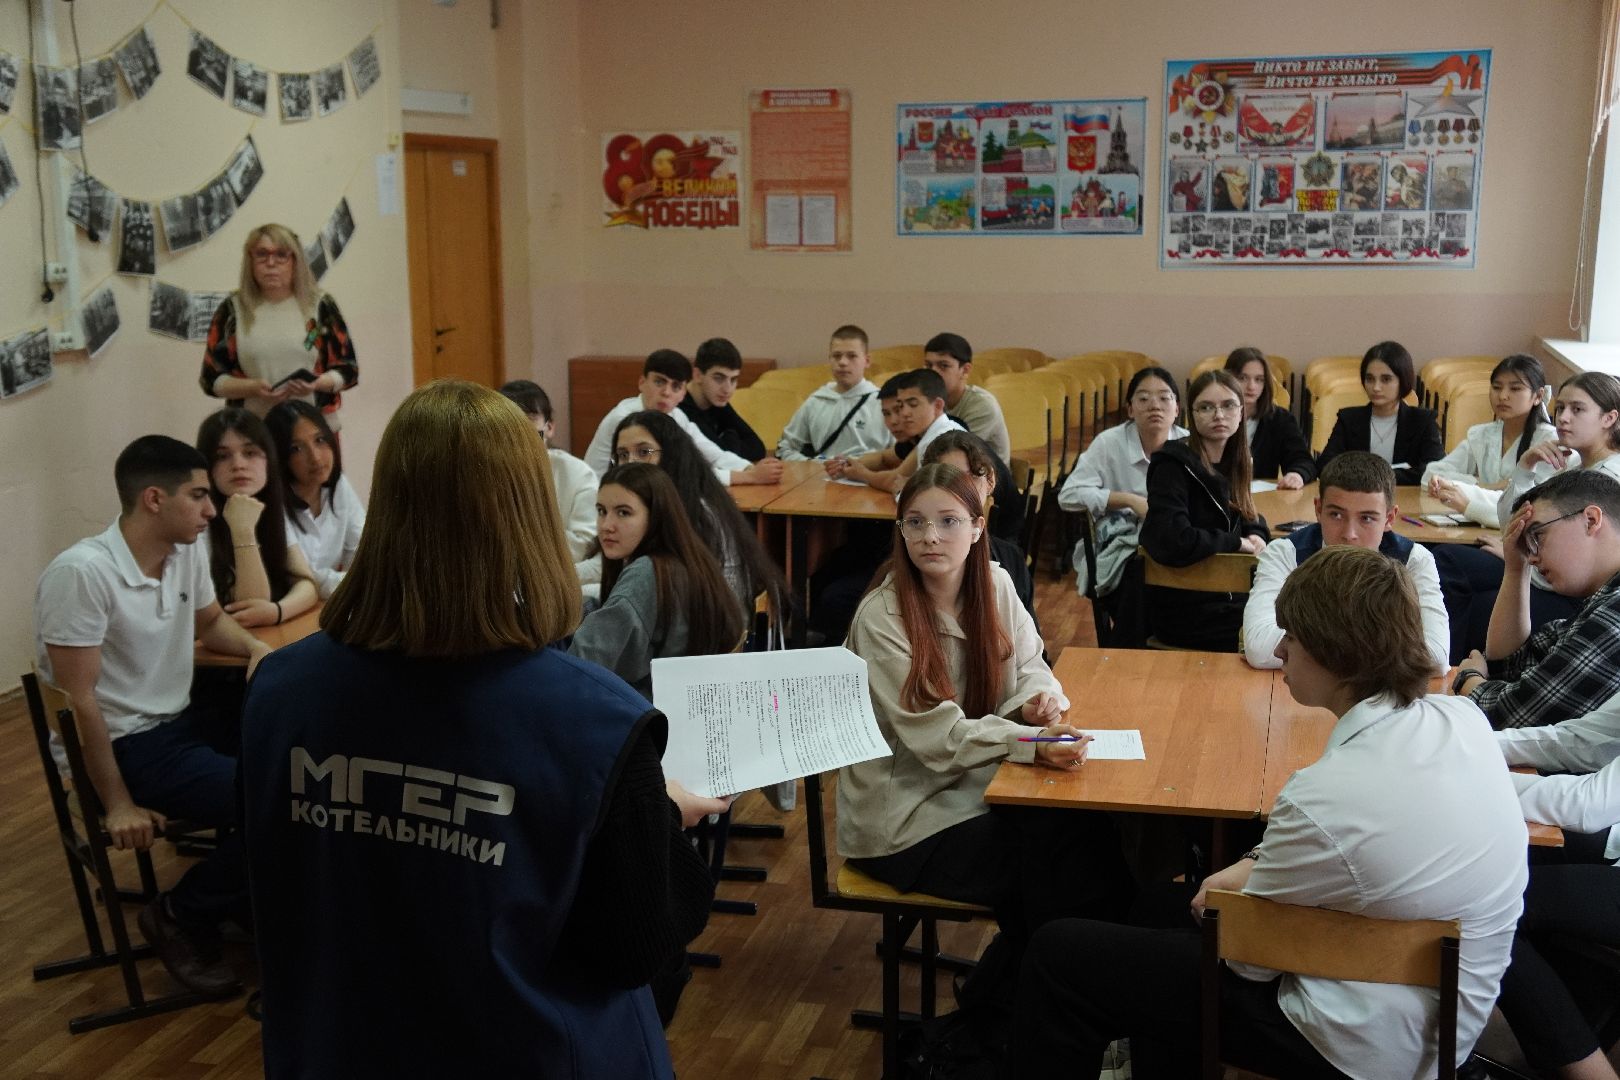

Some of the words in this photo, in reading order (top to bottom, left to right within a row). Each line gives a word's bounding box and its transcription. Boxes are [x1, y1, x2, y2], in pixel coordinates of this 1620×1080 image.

[1253, 60, 1301, 74] НИКТО
[1305, 60, 1325, 73] НЕ
[1327, 58, 1379, 72] ЗАБЫТ,
[1265, 74, 1314, 88] НИЧТО
[1317, 74, 1338, 87] НЕ
[1340, 73, 1398, 87] ЗАБЫТО
[604, 133, 687, 209] 80
[643, 200, 740, 229] ПОБЕДЫ
[290, 746, 516, 826] МГЕР
[291, 799, 506, 867] КОТЕЛЬНИКИ
